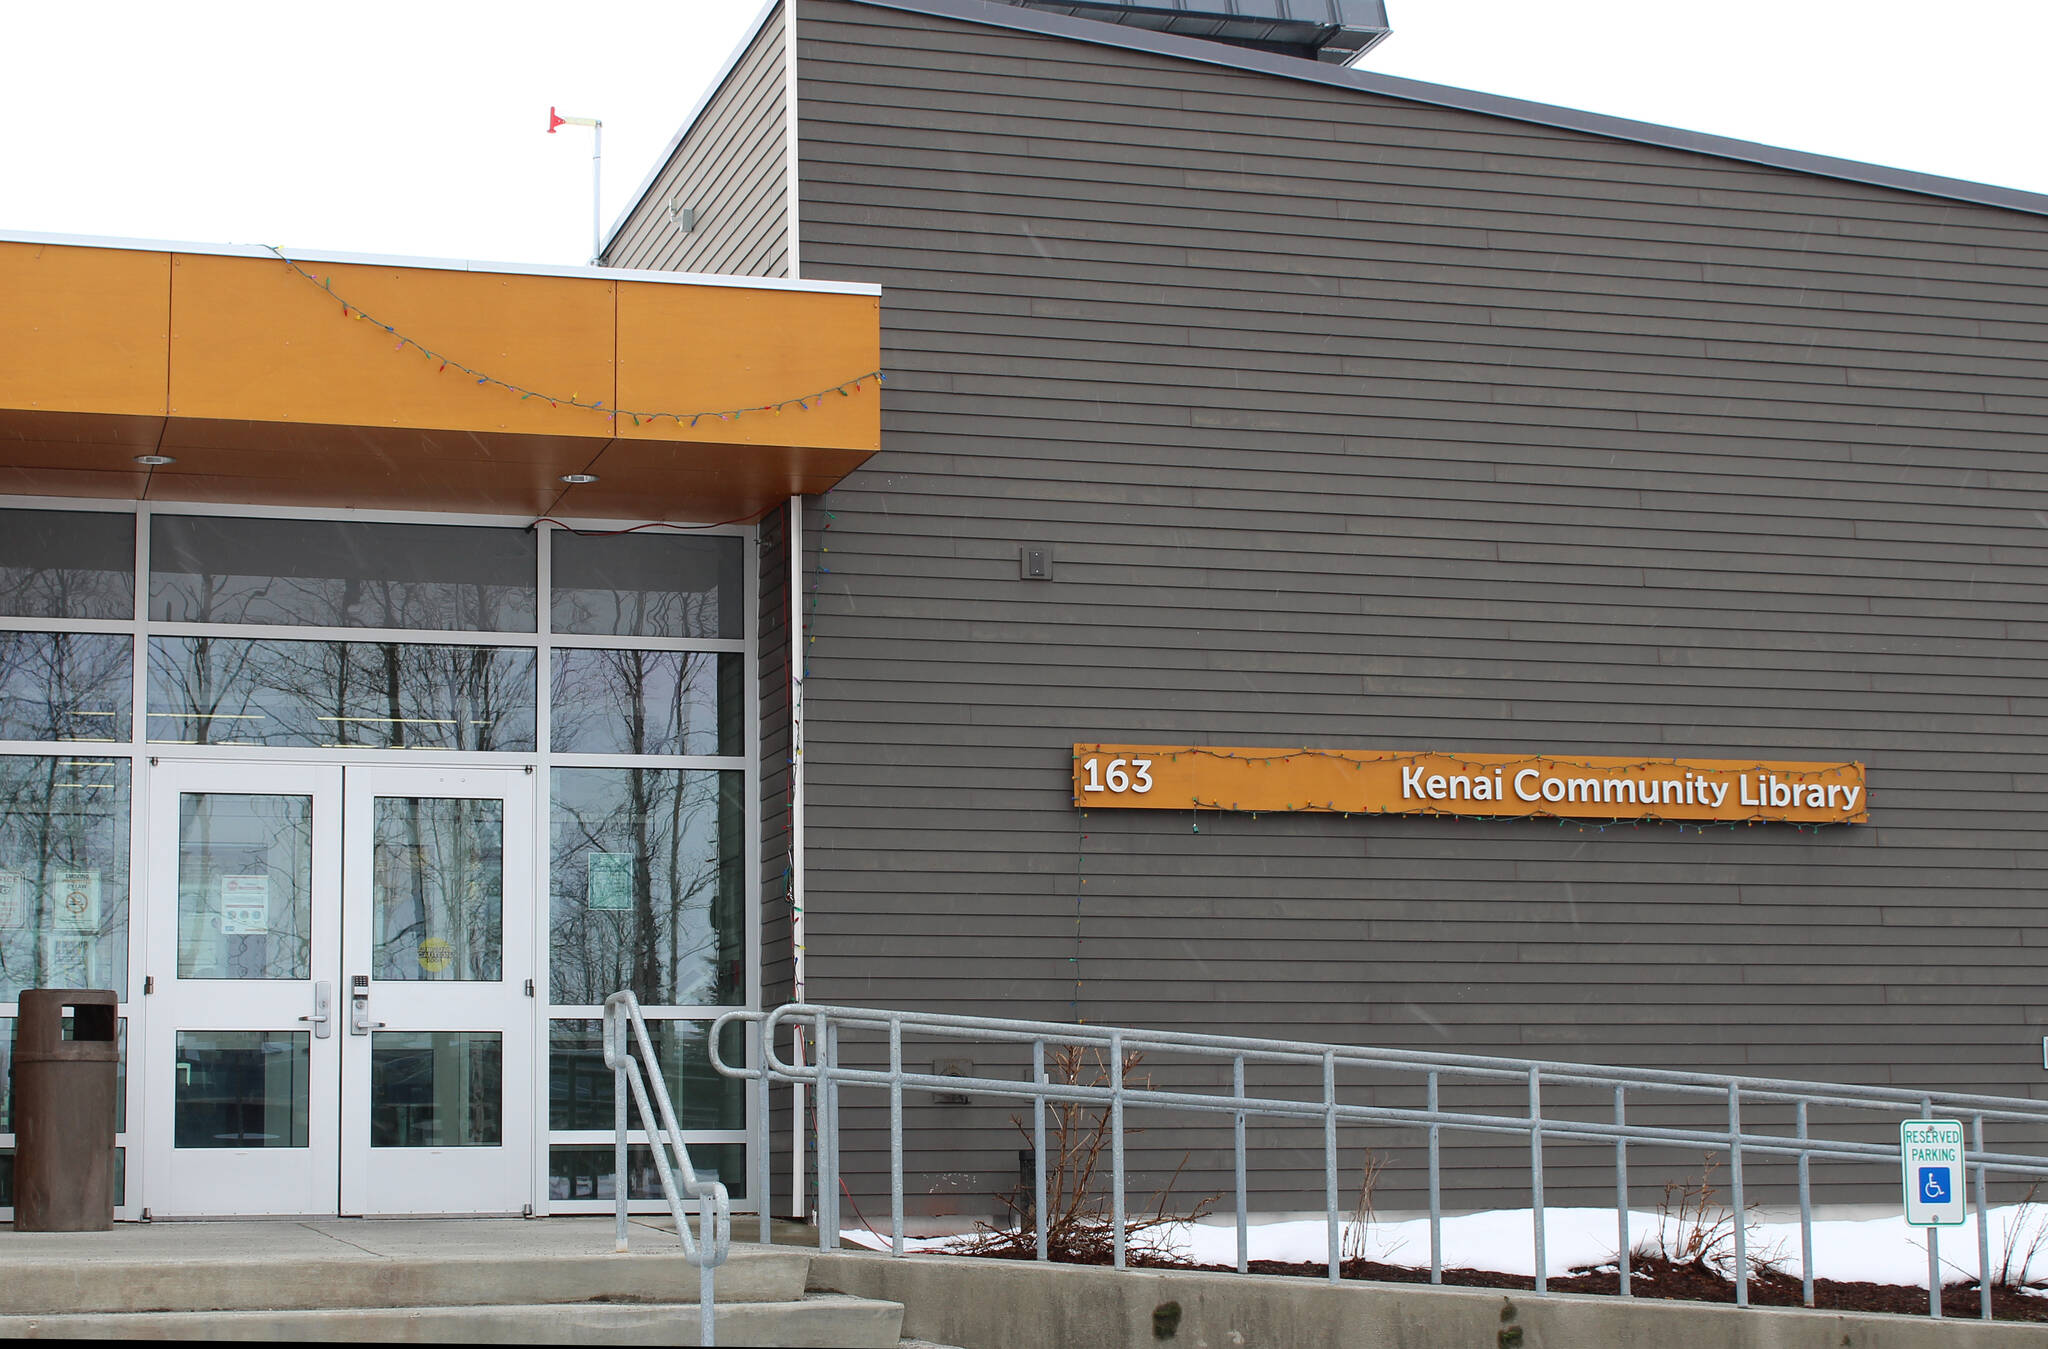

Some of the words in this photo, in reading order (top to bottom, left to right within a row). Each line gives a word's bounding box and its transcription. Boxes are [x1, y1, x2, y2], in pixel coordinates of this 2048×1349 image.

[1083, 758, 1154, 794] 163
[1402, 766, 1503, 801] Kenai
[1513, 768, 1729, 808] Community
[1740, 773, 1861, 811] Library
[1905, 1130, 1959, 1144] RESERVED
[1912, 1148, 1955, 1162] PARKING
